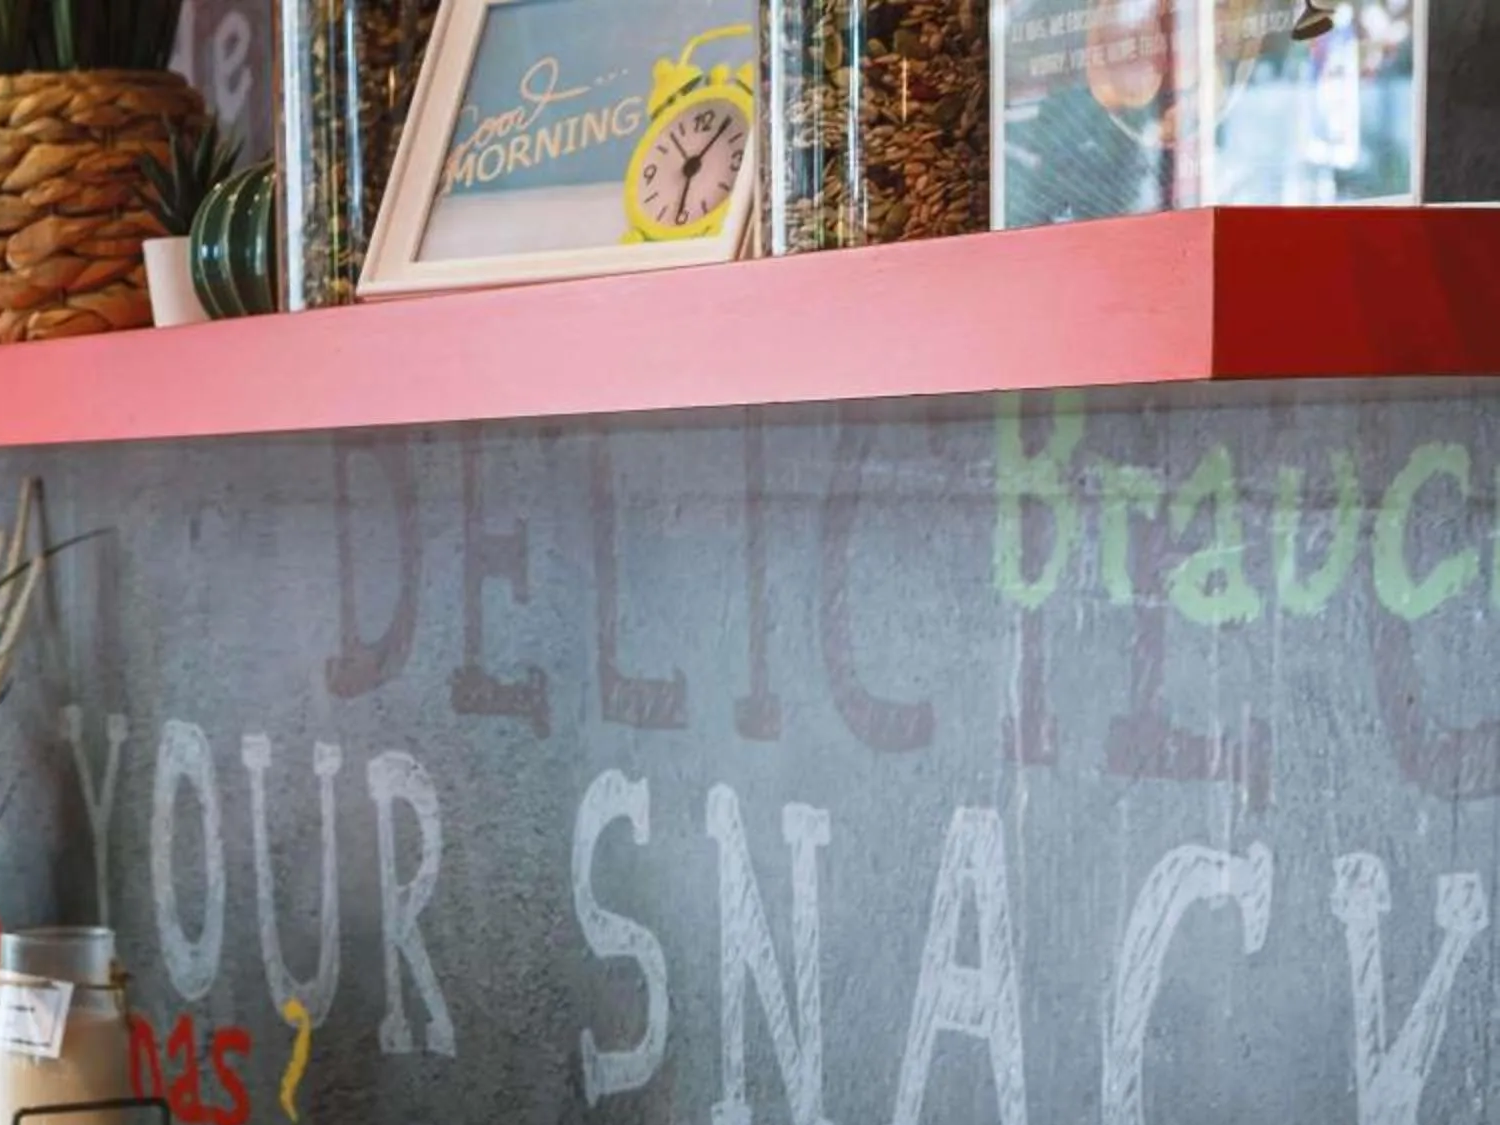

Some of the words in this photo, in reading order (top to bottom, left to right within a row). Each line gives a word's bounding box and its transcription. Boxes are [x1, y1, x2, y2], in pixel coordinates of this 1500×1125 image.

[442, 96, 645, 192] MORNING
[995, 393, 1500, 624] Brauc
[59, 701, 456, 1062] YOUR
